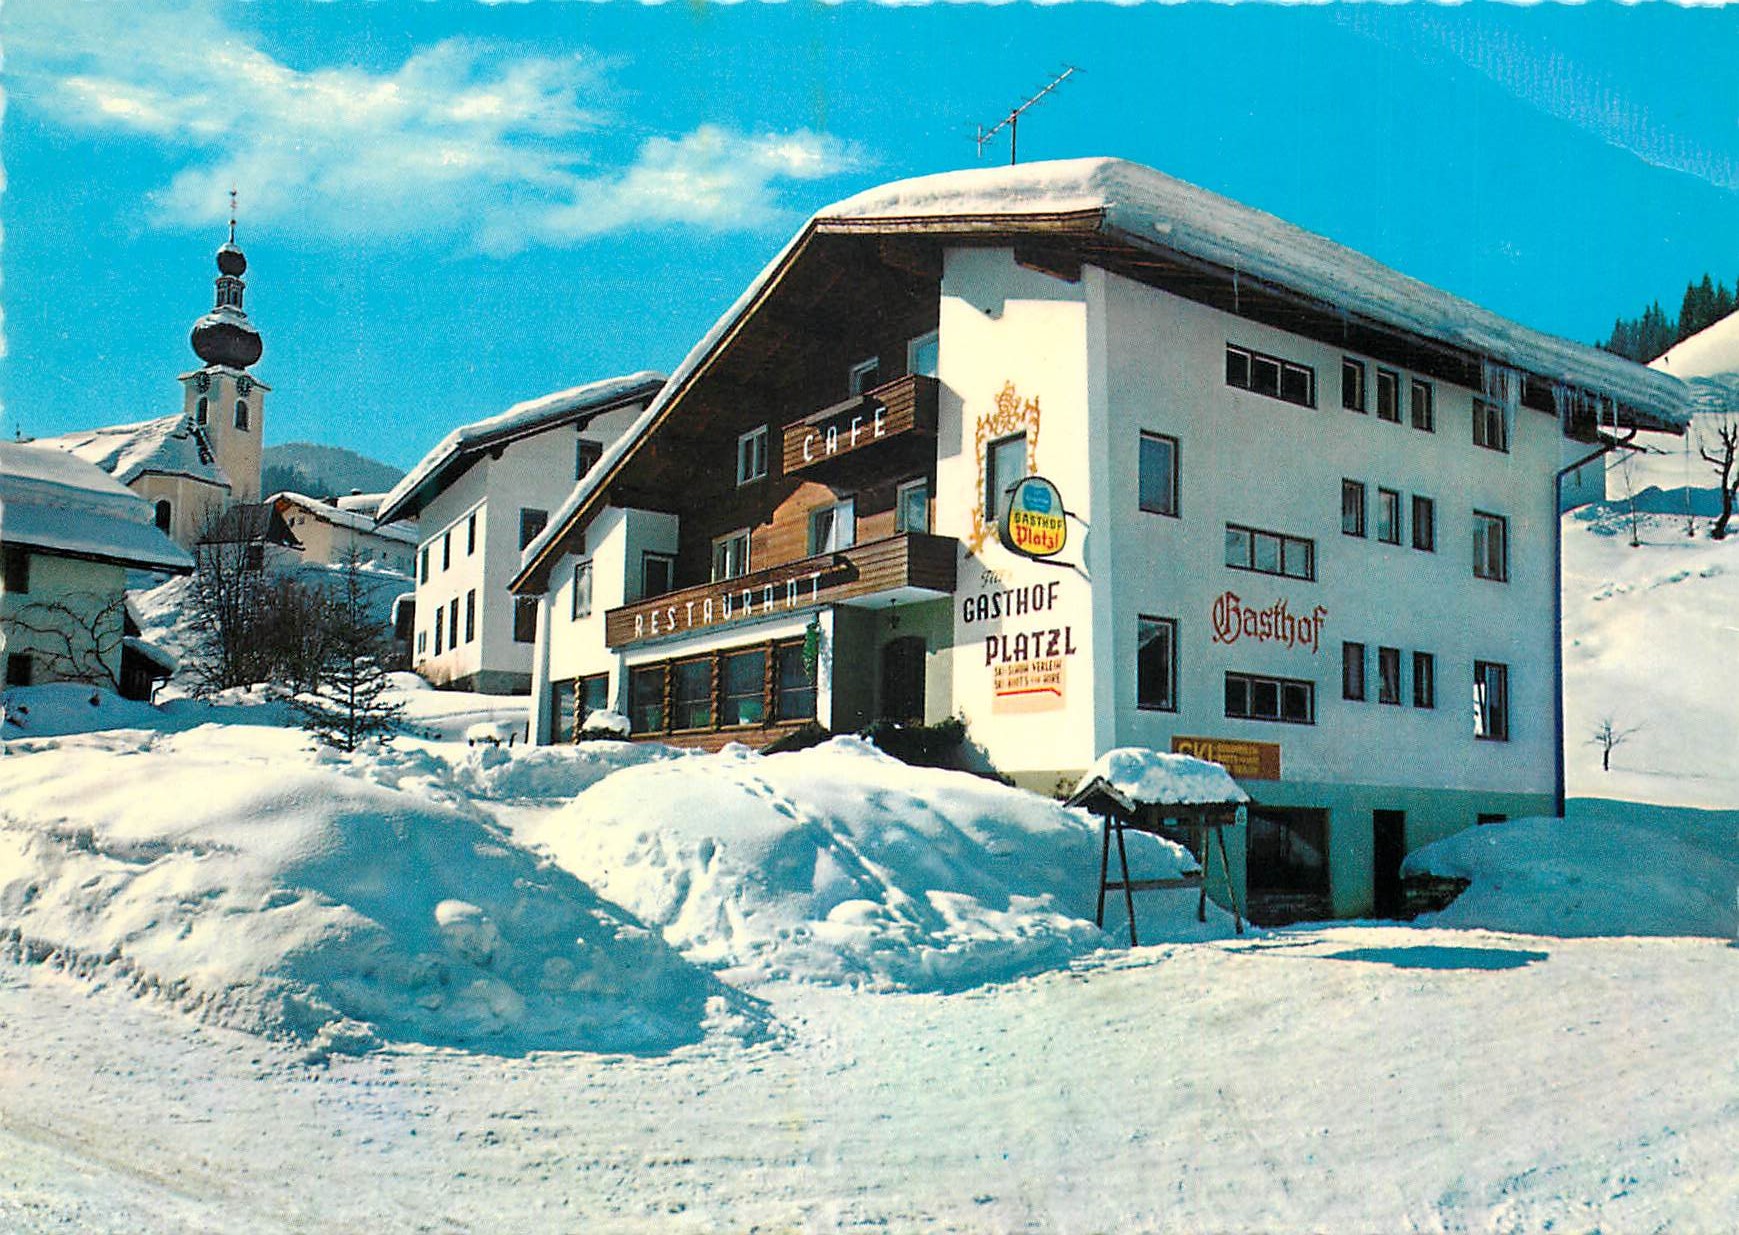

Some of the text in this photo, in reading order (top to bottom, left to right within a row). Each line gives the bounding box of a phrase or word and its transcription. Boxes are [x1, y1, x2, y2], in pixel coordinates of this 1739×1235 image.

[802, 406, 888, 463] CAFE
[1014, 512, 1063, 529] GASTHOF
[634, 573, 821, 638] RESTAURANT
[963, 581, 1060, 623] GASTHOF
[1212, 591, 1328, 654] Gasthof
[985, 626, 1077, 667] PLATZL
